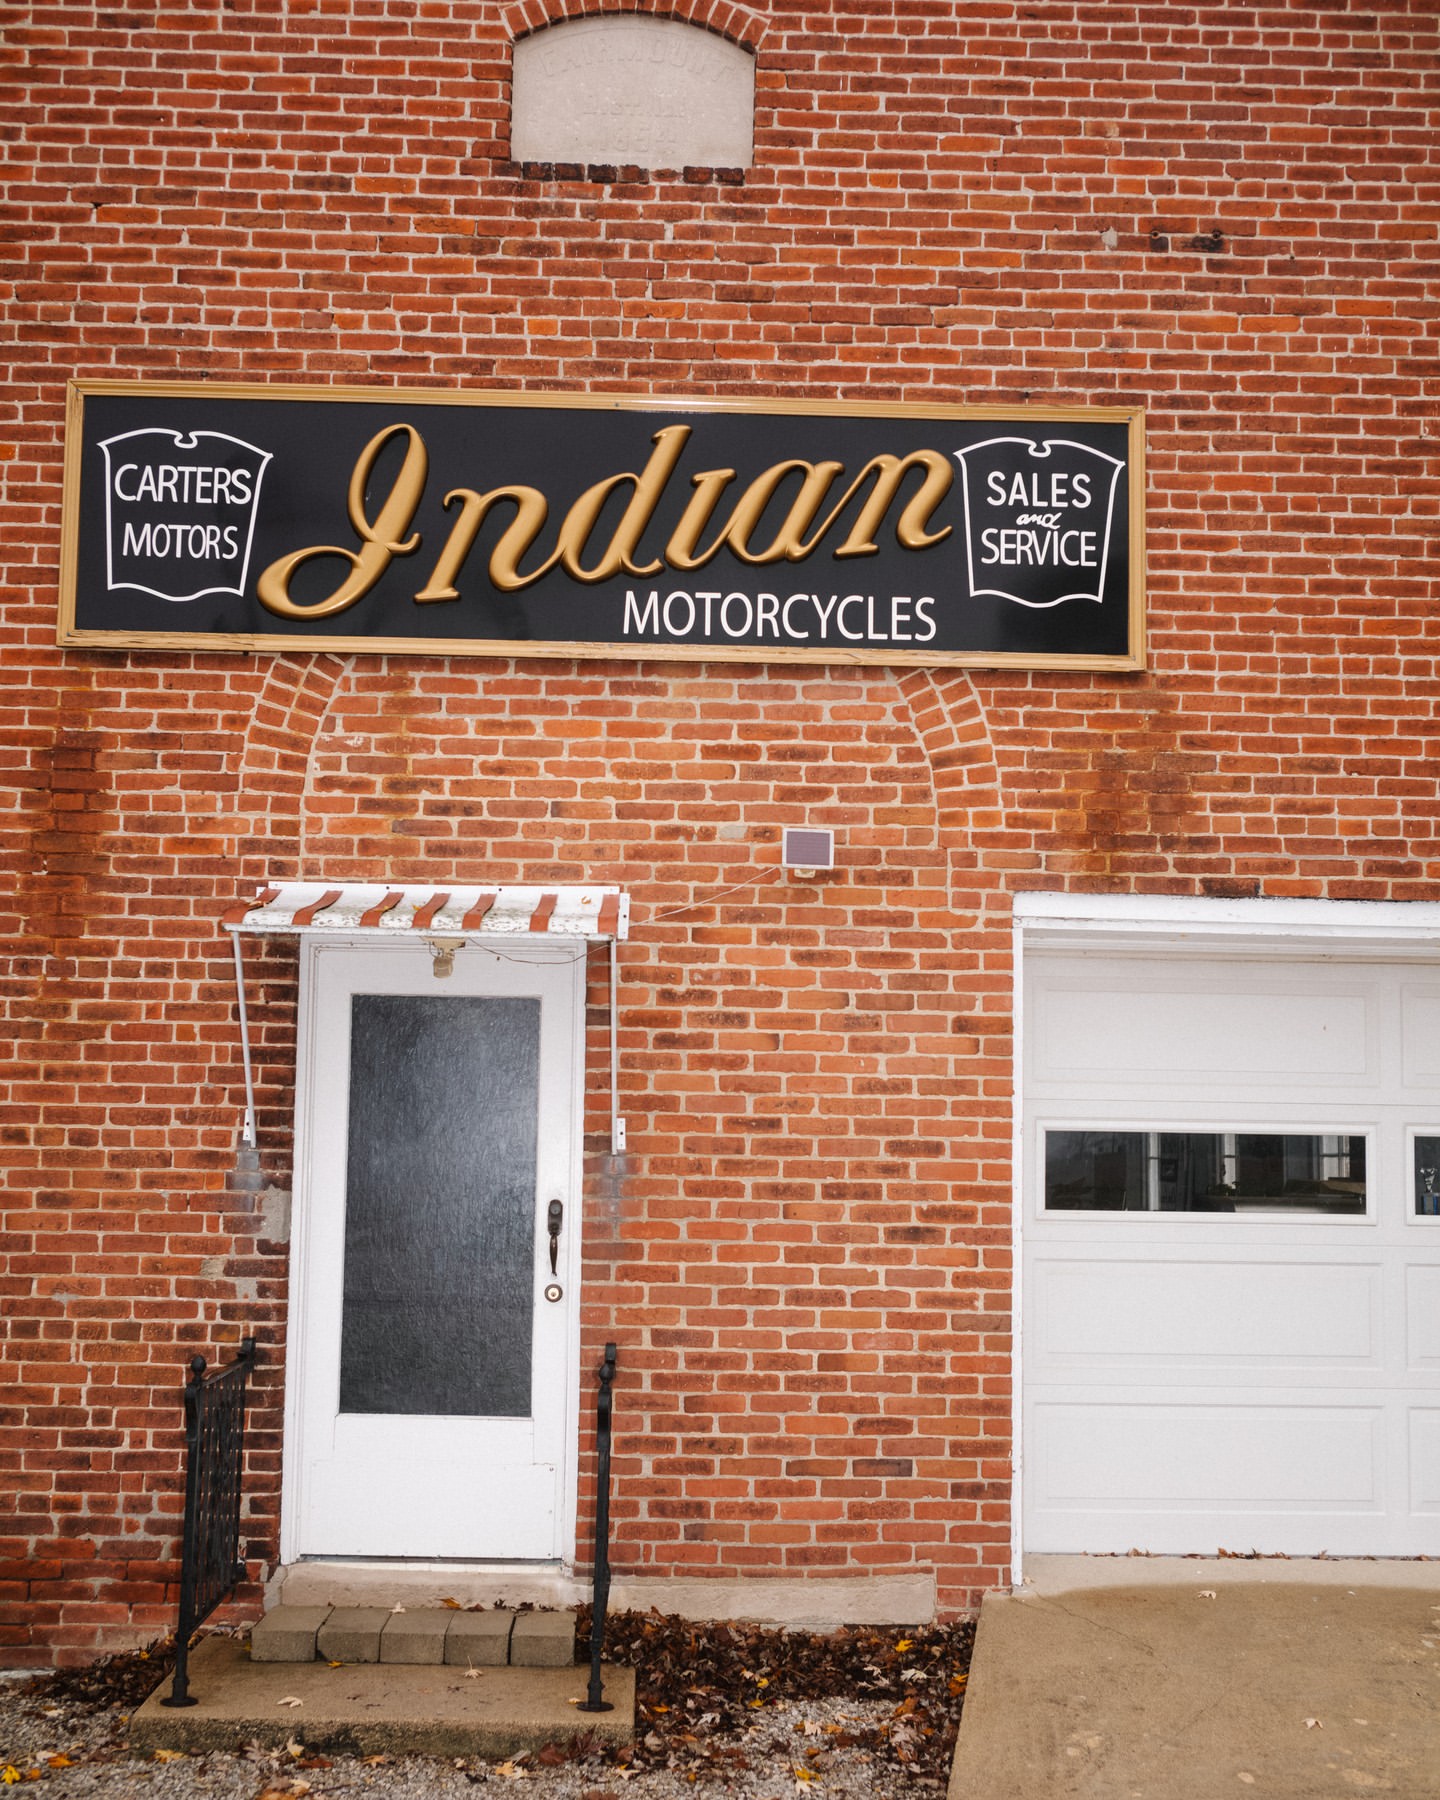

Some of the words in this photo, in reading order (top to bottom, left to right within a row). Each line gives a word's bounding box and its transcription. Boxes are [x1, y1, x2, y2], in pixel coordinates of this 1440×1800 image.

[114, 463, 252, 505] CARTERS
[986, 470, 1092, 509] SALES
[122, 522, 239, 560] MOTORS
[256, 423, 954, 621] Indian
[1015, 512, 1063, 530] and
[980, 527, 1098, 567] SERVICE
[622, 590, 937, 642] MOTORCYCLES
